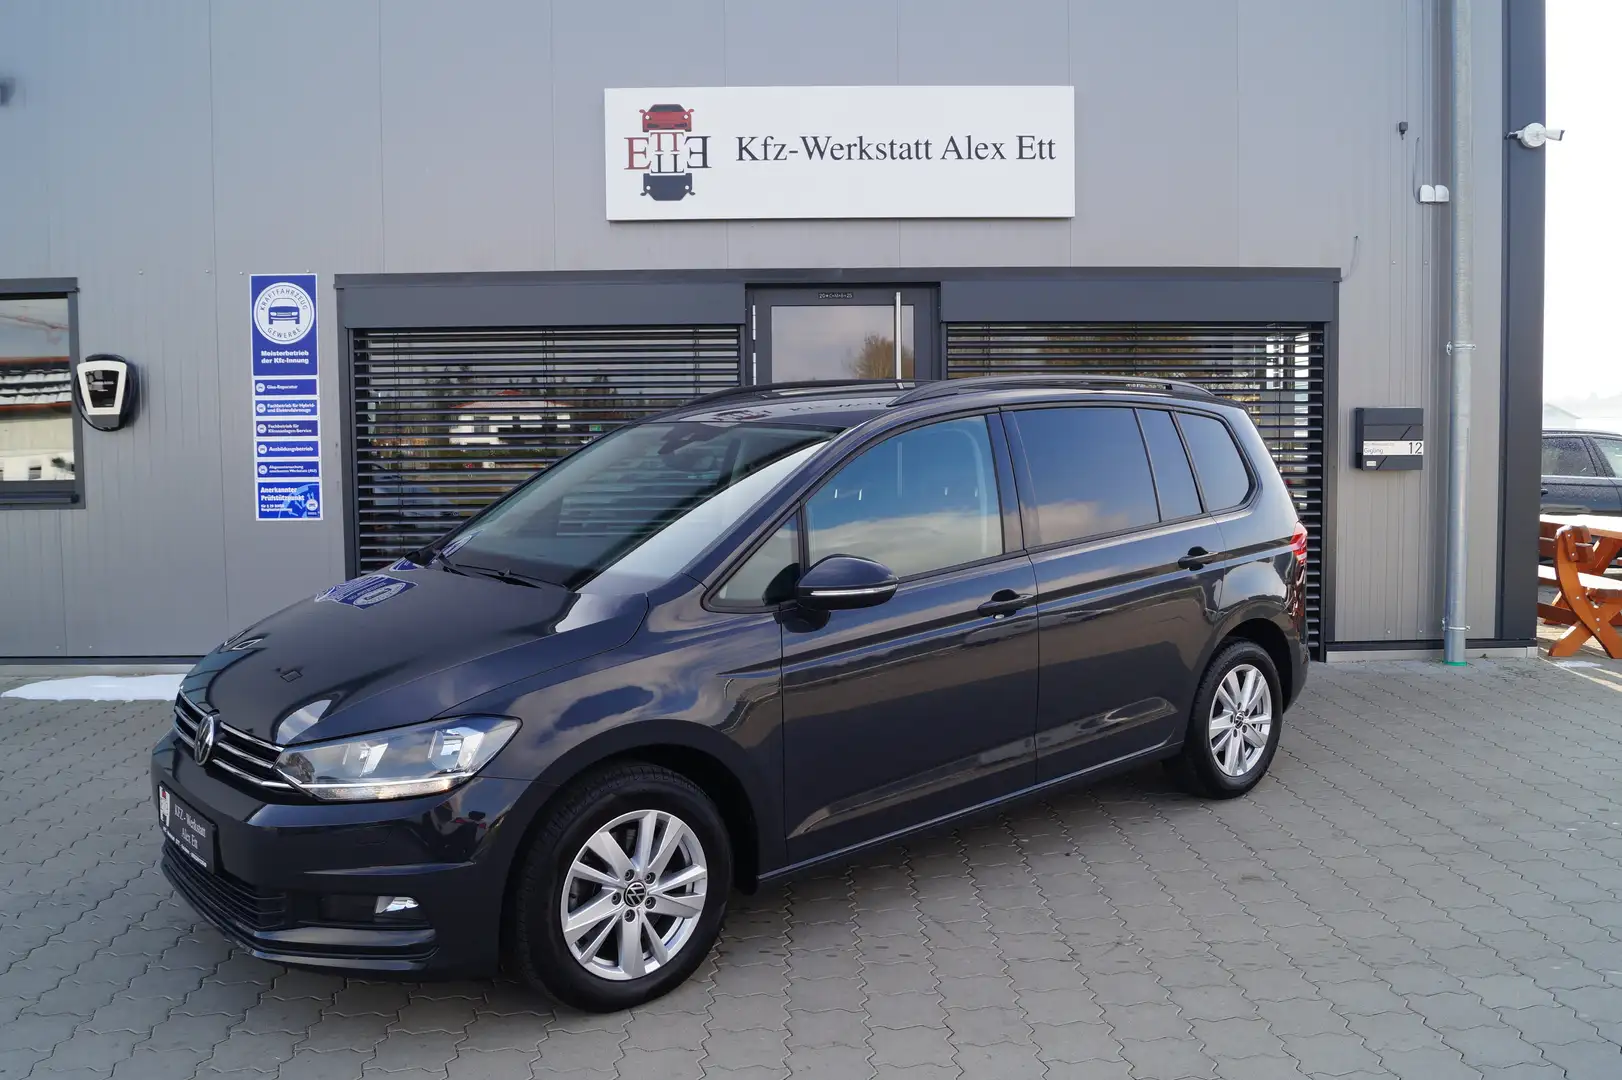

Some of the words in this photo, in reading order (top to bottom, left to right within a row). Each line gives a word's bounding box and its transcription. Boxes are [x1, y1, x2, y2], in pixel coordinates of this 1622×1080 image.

[735, 134, 933, 161] Kfz-Werkstatt
[940, 134, 1007, 160] Alex
[1015, 134, 1057, 160] Ett
[260, 288, 308, 311] KRAFTFAHRZEUG
[267, 326, 301, 339] GEWERBE
[1409, 442, 1422, 454] 12
